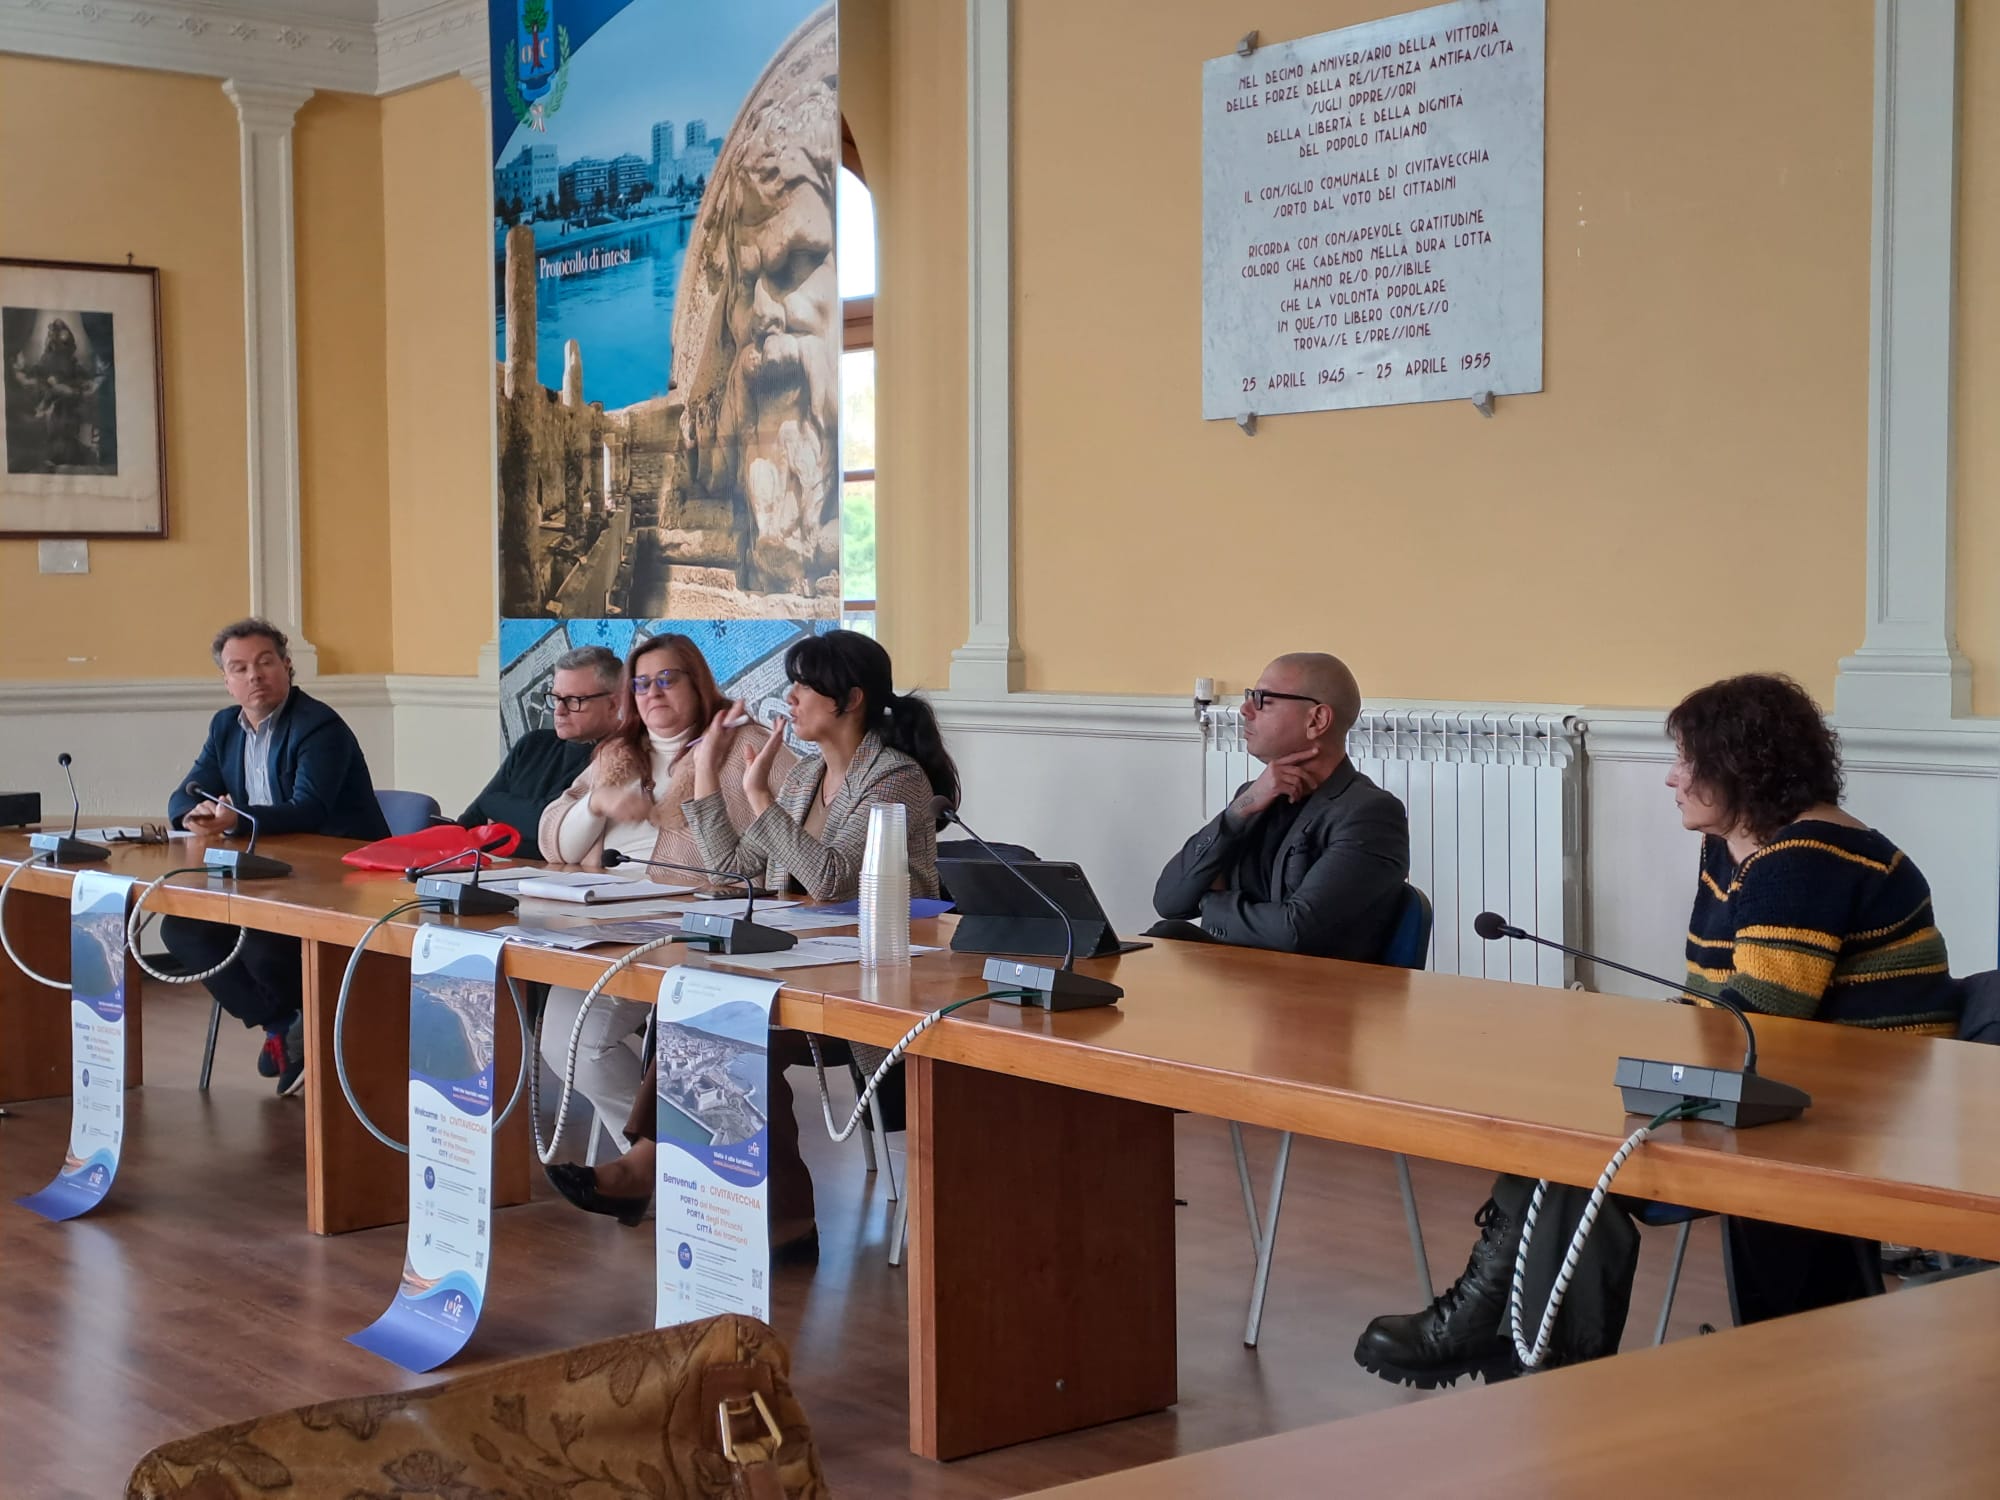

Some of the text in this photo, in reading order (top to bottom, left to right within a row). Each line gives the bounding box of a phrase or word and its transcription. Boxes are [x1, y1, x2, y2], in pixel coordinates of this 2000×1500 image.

[1238, 21, 1499, 90] NEL DECIMO ANNIVERSARIO DELLA VITTORIA
[1226, 39, 1514, 113] DELLE FORZE DELLA RESISTENZA ANTIFASCISTA
[1310, 81, 1416, 115] SUGLI OPPRESSORI
[1267, 127, 1302, 145] DELLA
[1359, 112, 1366, 126] E
[1373, 104, 1411, 124] DELLA
[1299, 121, 1427, 158] DEL POPOLO ITALIANO
[1244, 149, 1490, 204] IL CONSIGLIO COMUNALE DI CIVITAVECCHIA
[1273, 175, 1456, 219] SORTO DAL VOTO DEI CITTADINI
[1248, 208, 1485, 258] RICORDA CON CONSAPEVOLE GRATITUDINE
[539, 247, 630, 279] Protocollo di intesa
[1241, 230, 1492, 279] COLORO CHE CADENDO NELLA DURA LOTTA
[1293, 259, 1432, 292] HANNO RESO POSSIBILE
[1280, 298, 1301, 313] CHE
[1307, 297, 1322, 310] LA
[1387, 278, 1447, 299] POPOLARE
[1277, 299, 1449, 334] IN QUESTO LIBERO CONSESSO
[1293, 322, 1432, 351] TROVASSE ESPRESSIONE
[1242, 376, 1257, 393] 25
[1268, 371, 1307, 390] APRILE
[1318, 367, 1345, 385] 1945
[1376, 362, 1392, 380] 25
[1405, 356, 1449, 377] APRILE
[1461, 352, 1491, 371] 1955
[663, 1172, 697, 1190] Benvenuti
[710, 1185, 761, 1210] CIVITAVECCHIA
[680, 1195, 699, 1206] PORTO
[686, 1208, 705, 1220] PORTA
[696, 1223, 713, 1234] CITTÀ
